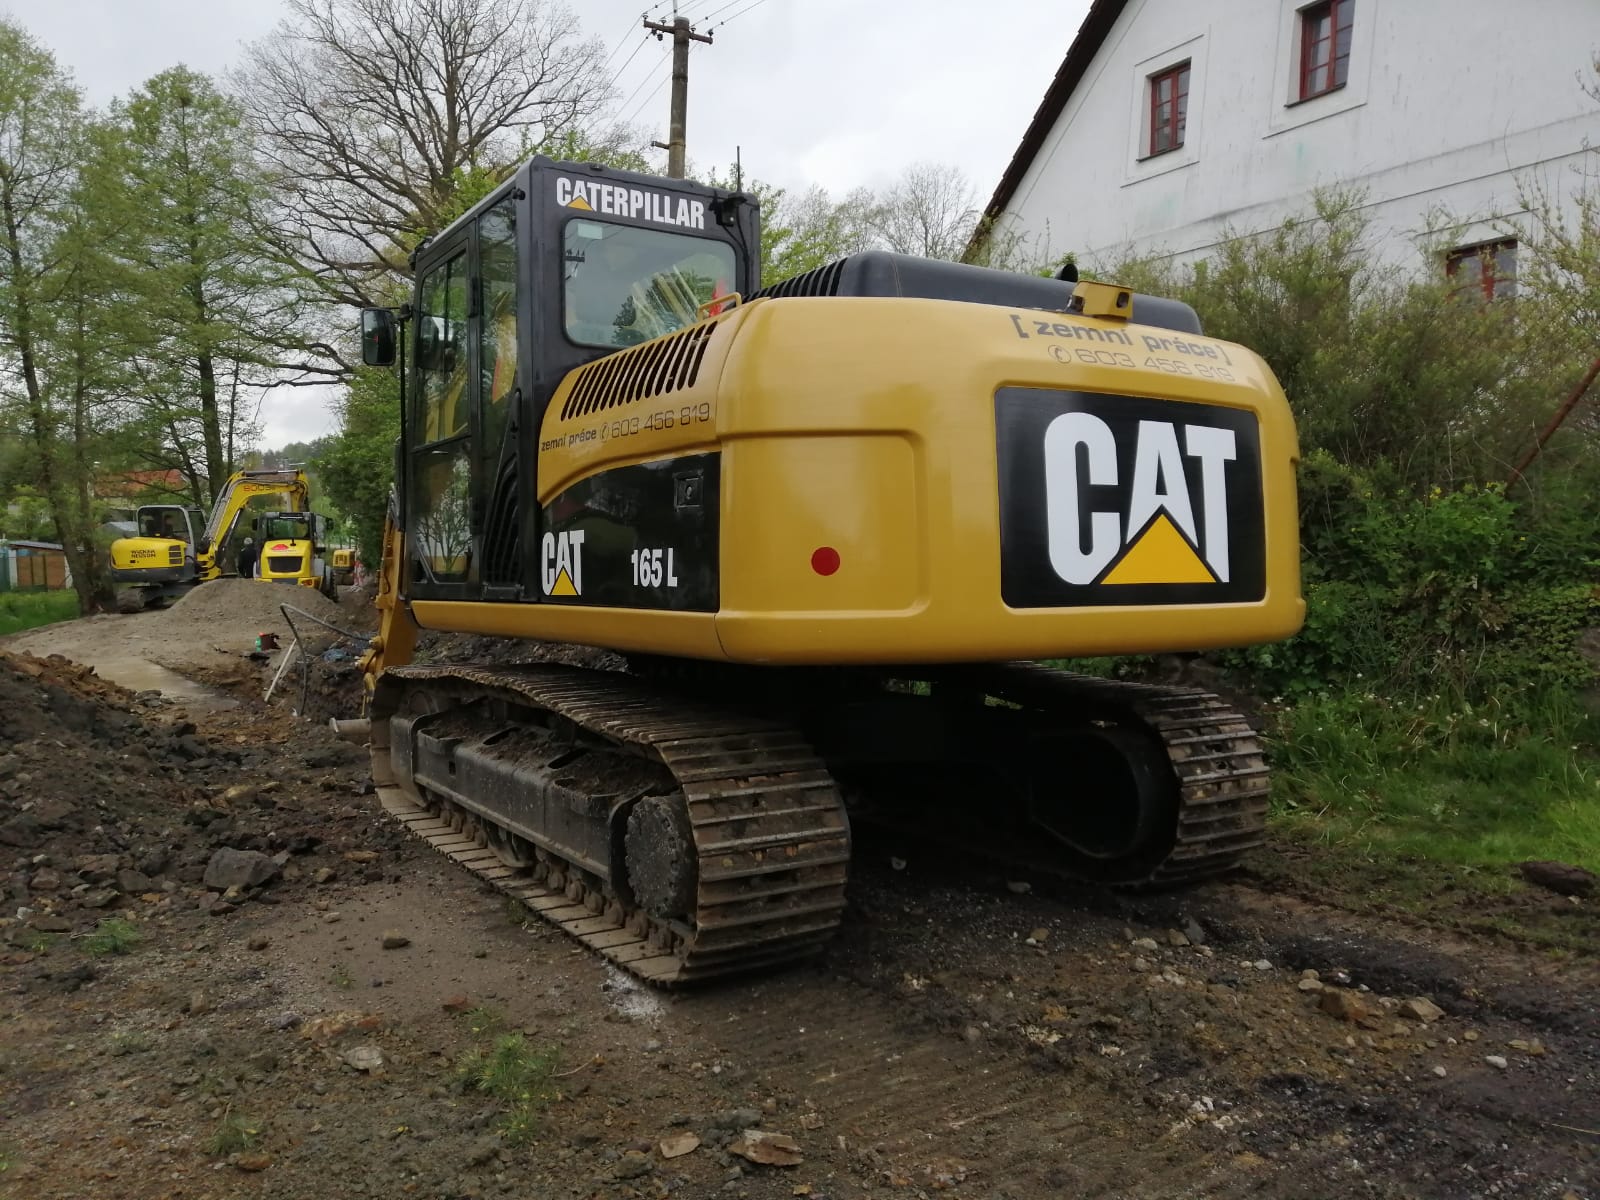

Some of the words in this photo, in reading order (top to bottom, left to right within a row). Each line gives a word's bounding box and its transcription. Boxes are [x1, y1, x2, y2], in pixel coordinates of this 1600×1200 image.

[556, 177, 704, 229] CATERPILLAR
[1033, 320, 1134, 346] zemní
[1078, 348, 1136, 368] 603
[1144, 355, 1193, 375] 456
[541, 432, 567, 452] zemní
[568, 428, 597, 448] práce
[611, 417, 640, 439] 603
[643, 410, 675, 432] 456
[680, 402, 710, 426] 819
[1044, 411, 1237, 585] CAT
[541, 529, 585, 596] CAT
